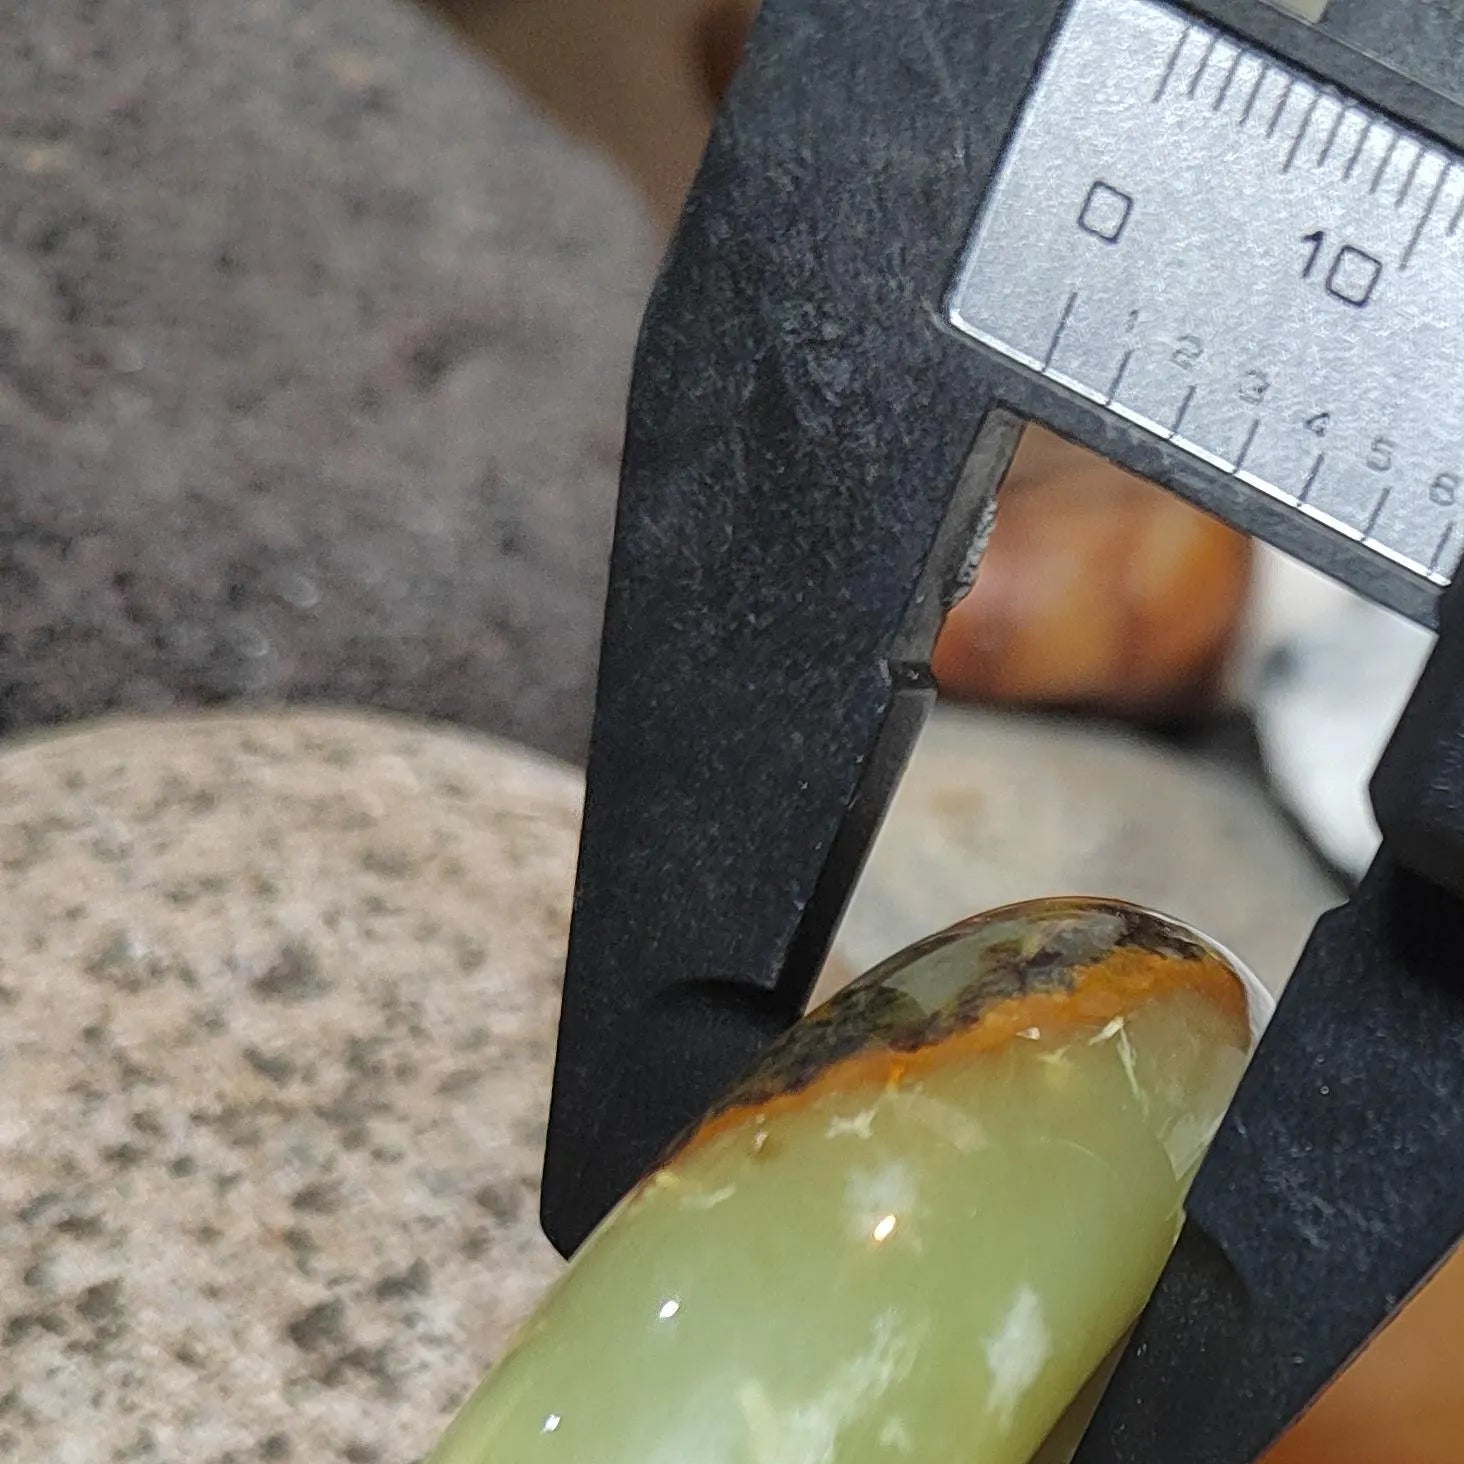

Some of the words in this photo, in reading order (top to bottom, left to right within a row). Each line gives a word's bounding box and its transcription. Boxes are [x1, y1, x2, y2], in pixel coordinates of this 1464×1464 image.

[1079, 180, 1133, 244] 0
[1300, 231, 1382, 307] 10
[1171, 335, 1204, 370] 2
[1238, 369, 1271, 406] 3
[1304, 410, 1332, 438] 4
[1365, 435, 1396, 473] 5
